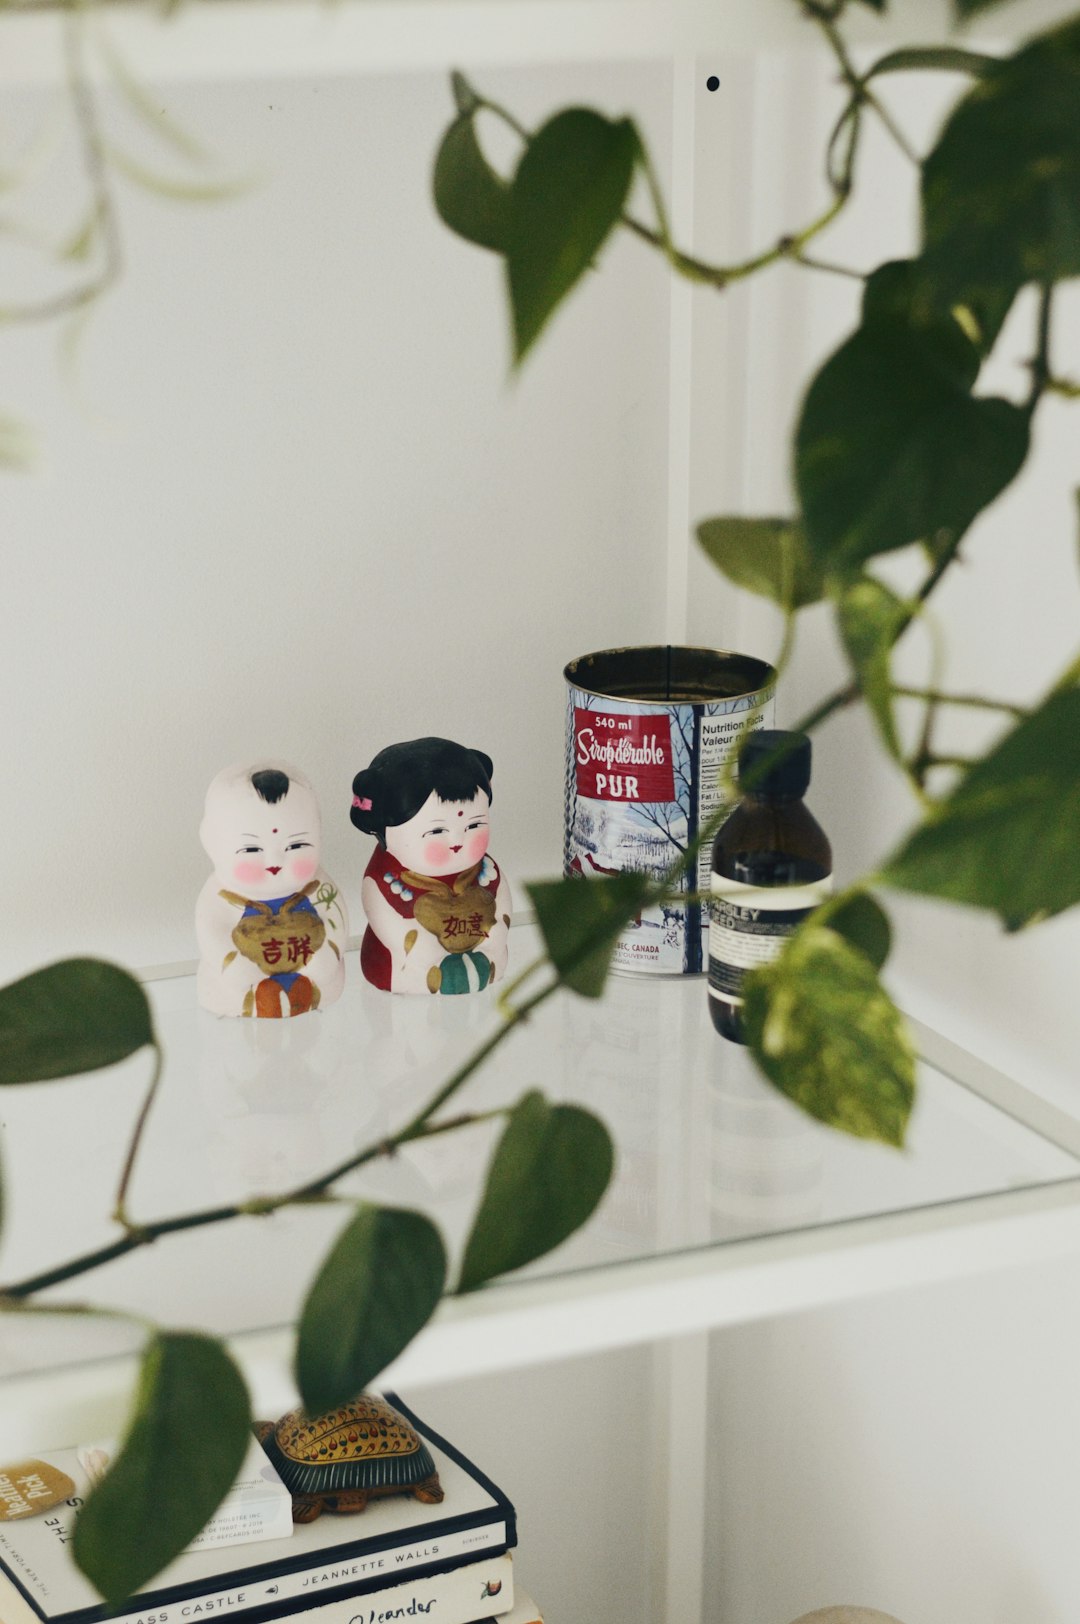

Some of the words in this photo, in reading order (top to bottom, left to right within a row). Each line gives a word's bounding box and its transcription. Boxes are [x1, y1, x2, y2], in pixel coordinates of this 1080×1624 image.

[595, 716, 615, 729] 540
[618, 719, 632, 730] ml
[702, 720, 744, 735] Nutrition
[702, 734, 733, 747] Valeur
[596, 772, 639, 799] PUR
[701, 792, 712, 801] Fat
[711, 899, 761, 922] ARSLEY
[441, 914, 489, 939] 如意
[261, 934, 315, 966] 吉祥
[632, 944, 660, 953] CANADA
[17, 1474, 53, 1499] Pick
[44, 1518, 73, 1544] THE
[126, 1612, 168, 1624] ASS
[181, 1592, 246, 1616] CASTLE
[302, 1559, 385, 1587] JEANNETTE
[395, 1545, 440, 1564] WALLS
